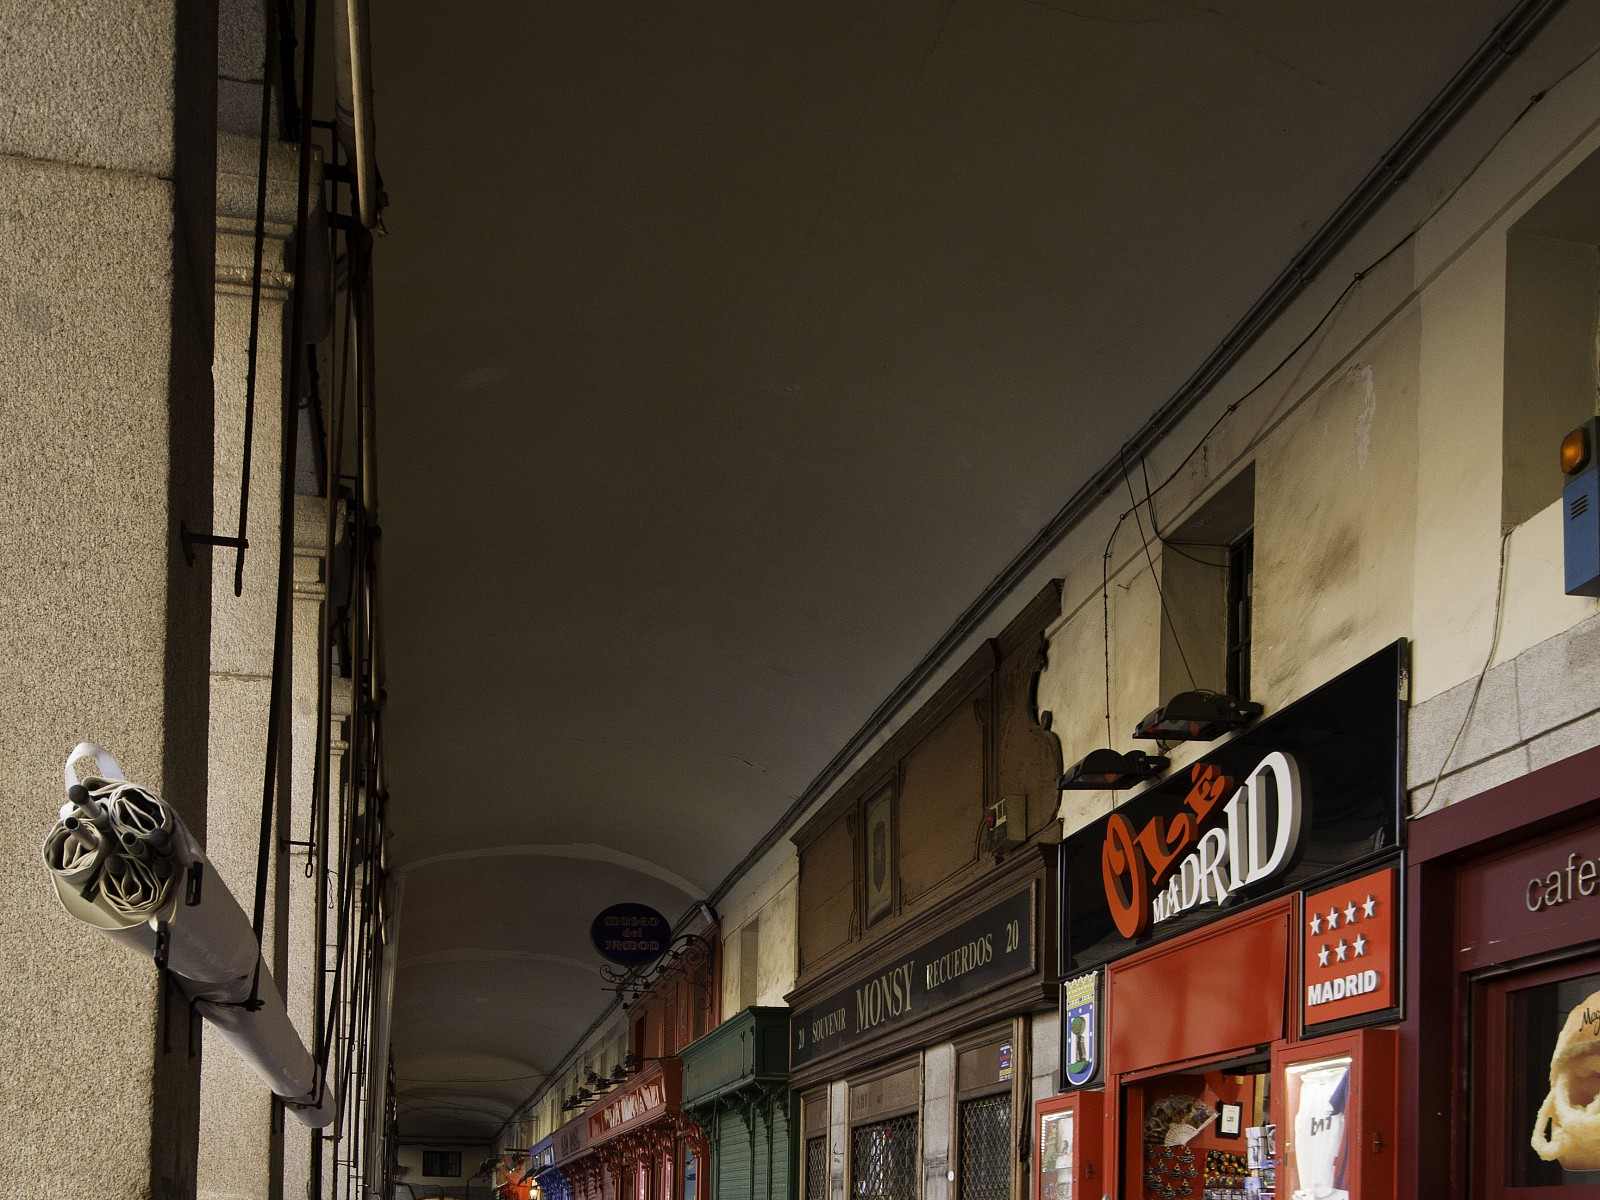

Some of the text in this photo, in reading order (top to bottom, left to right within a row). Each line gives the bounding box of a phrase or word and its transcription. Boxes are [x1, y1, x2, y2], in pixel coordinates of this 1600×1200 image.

[1153, 751, 1300, 925] MADRID
[1526, 852, 1600, 912] cafe
[812, 1007, 846, 1043] SOUVENIR
[856, 960, 914, 1034] MONSY
[926, 933, 993, 991] RECUERDOS
[1005, 919, 1019, 954] 20
[1307, 969, 1377, 1006] MADRID
